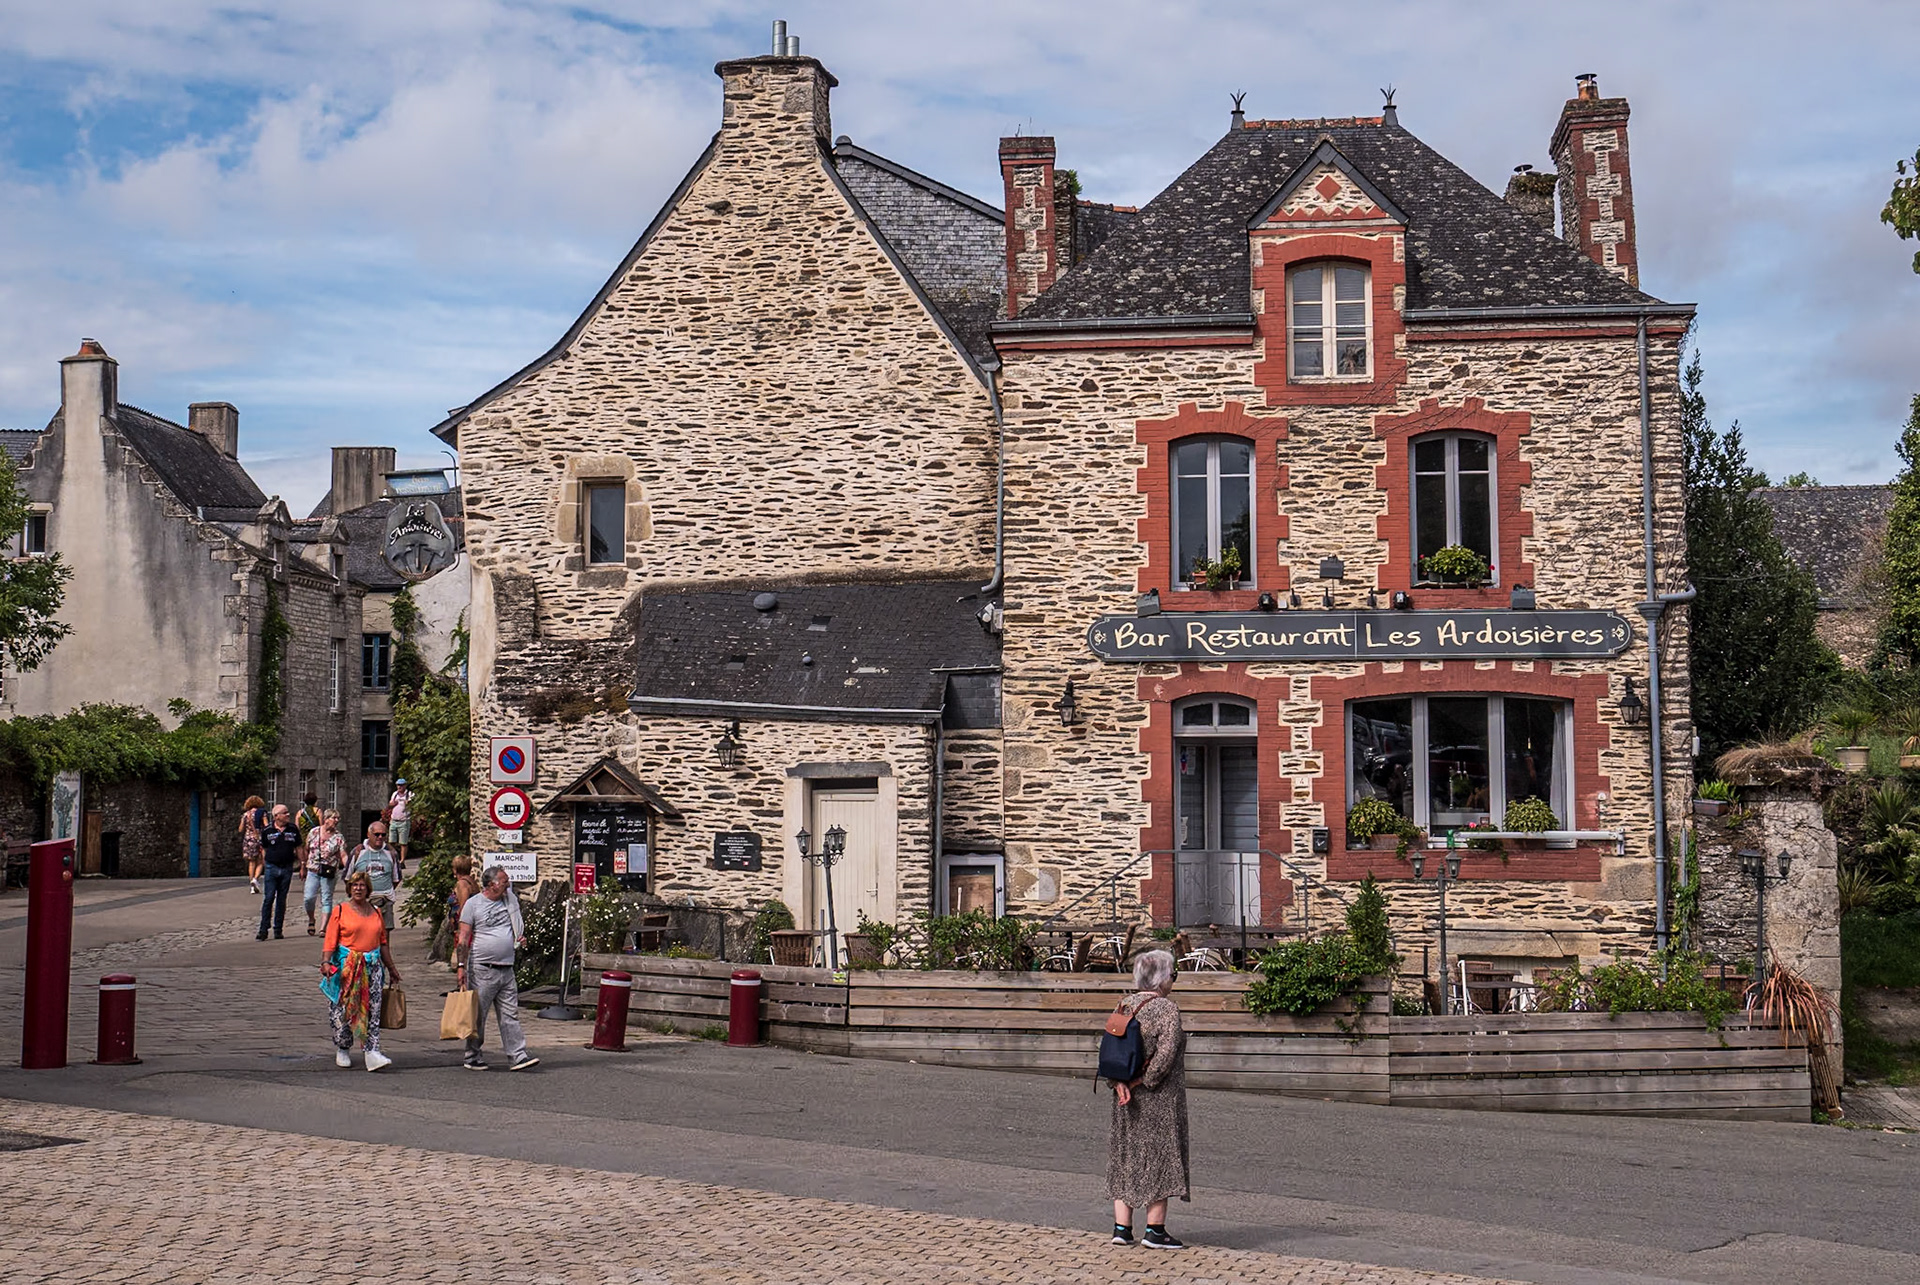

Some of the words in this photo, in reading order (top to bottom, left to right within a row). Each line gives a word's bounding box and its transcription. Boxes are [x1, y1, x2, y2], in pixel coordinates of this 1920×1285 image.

[1115, 622, 1170, 649] Bar
[1187, 622, 1355, 655] Restaurant
[1365, 622, 1420, 648] Les
[1438, 620, 1604, 649] Ardoisières
[495, 854, 524, 862] MARCHÉ
